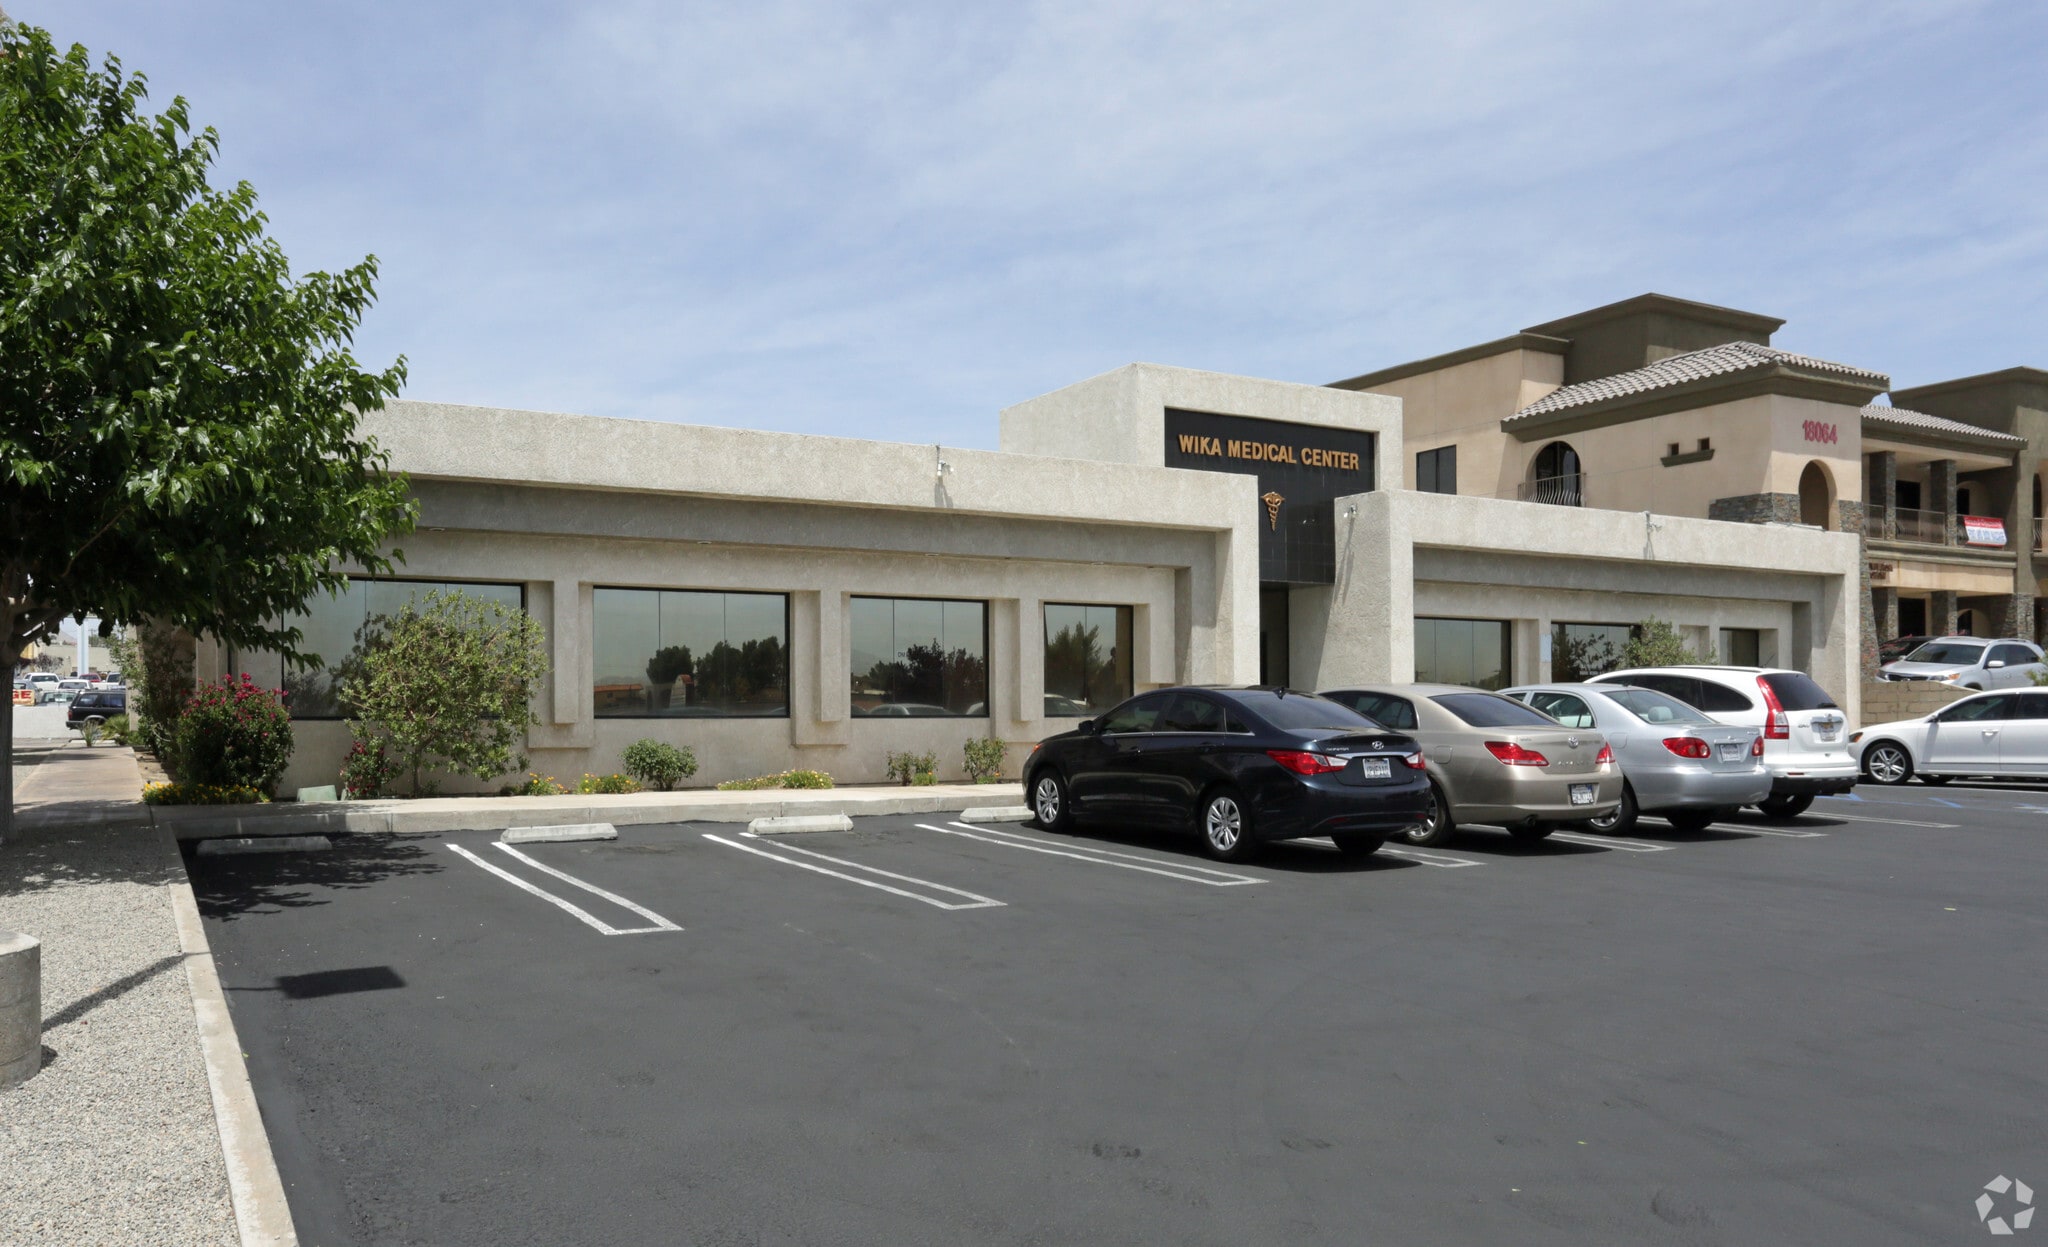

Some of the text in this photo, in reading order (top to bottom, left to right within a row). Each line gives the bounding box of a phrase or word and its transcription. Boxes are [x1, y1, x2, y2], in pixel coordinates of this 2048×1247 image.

[1802, 420, 1838, 445] 18064
[1178, 434, 1359, 470] WIKA MEDICAL CENTER
